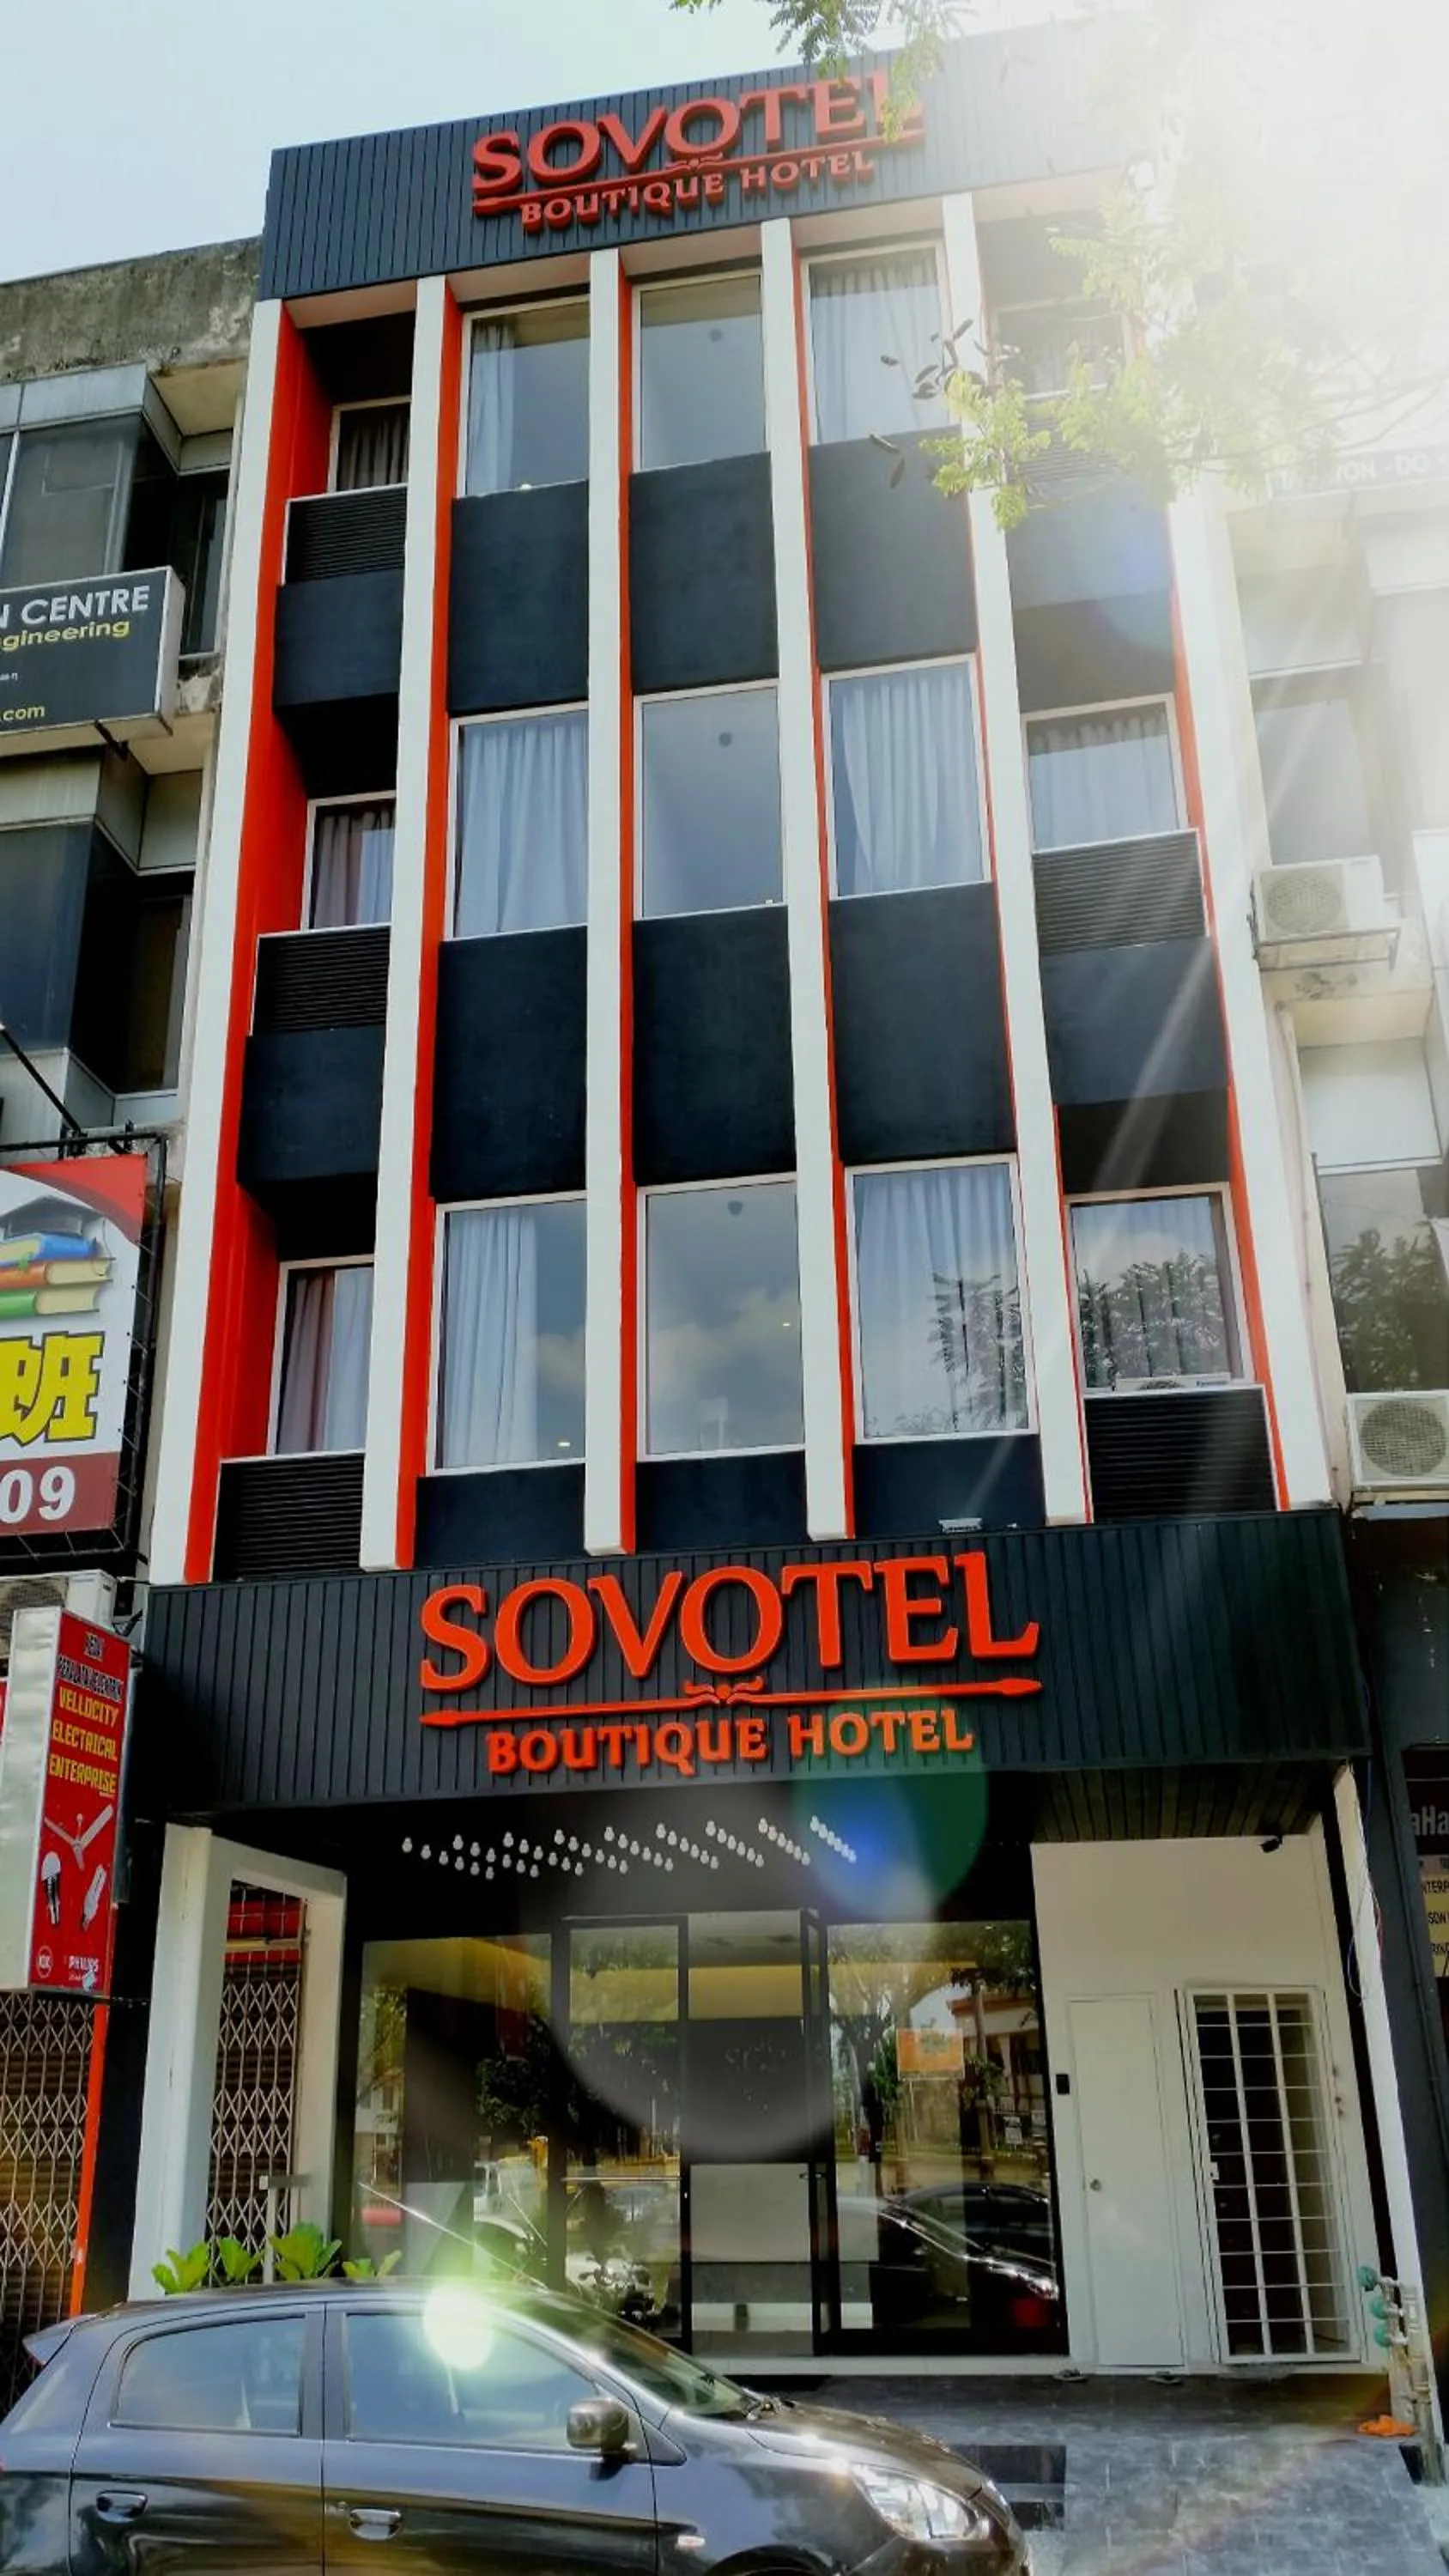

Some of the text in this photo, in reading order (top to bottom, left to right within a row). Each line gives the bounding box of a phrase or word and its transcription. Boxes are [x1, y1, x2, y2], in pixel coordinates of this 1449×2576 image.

[472, 71, 925, 195] SOVOTEL
[520, 149, 874, 233] BOUTIQUE HOTEL
[21, 585, 150, 625] CENTRE
[420, 1551, 1040, 1694] SOVOTEL
[59, 1686, 119, 1728] VELLOCITY
[52, 1718, 118, 1761] ELECTRICAL
[487, 1707, 974, 1776] BOUTIQUE HOTEL
[50, 1753, 118, 1794] ENTERPRISE
